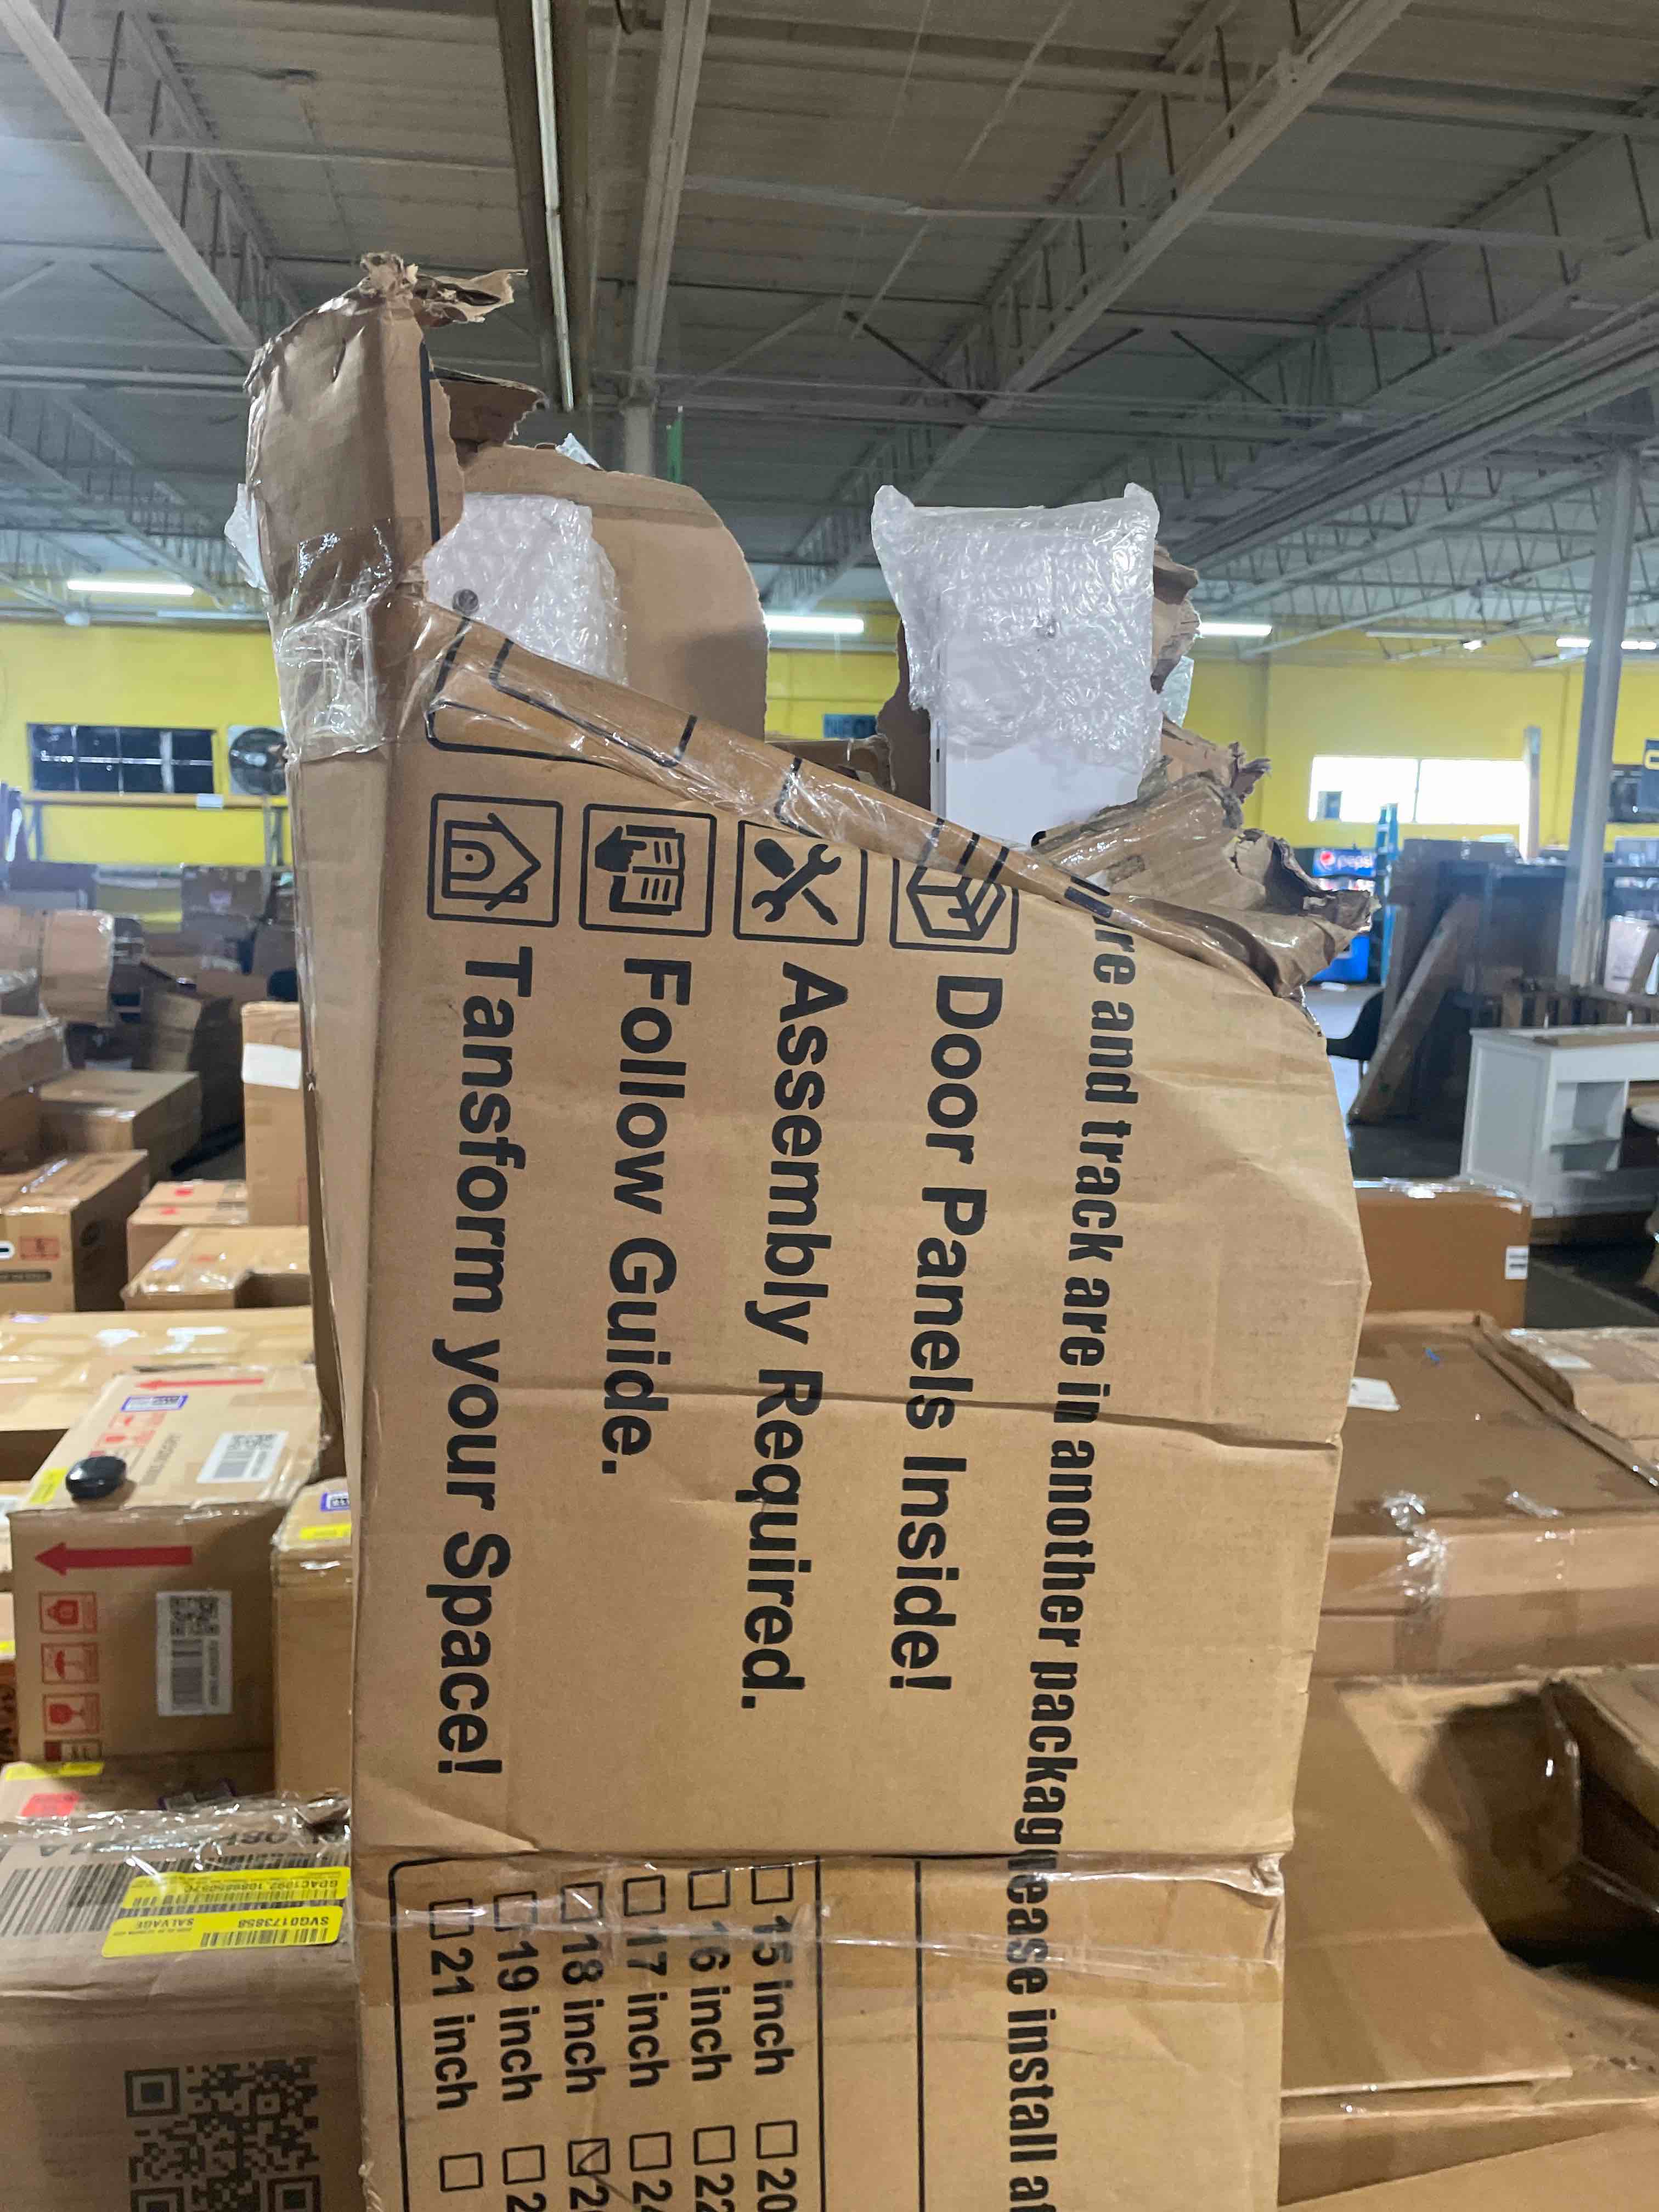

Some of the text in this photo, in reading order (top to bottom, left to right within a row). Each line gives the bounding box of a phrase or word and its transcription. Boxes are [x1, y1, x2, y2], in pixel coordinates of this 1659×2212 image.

[1093, 916, 1136, 984] re
[1085, 1001, 1138, 1103] and
[602, 958, 692, 1474] Follow Guide.
[1069, 1121, 1132, 1261] track
[427, 946, 533, 1774] Tansform your Space!
[736, 962, 848, 1708] Assembly Required.
[890, 976, 1003, 1690] Door Panels Inside!
[1060, 1277, 1110, 1365] are
[1054, 1383, 1110, 1423] in
[1039, 1441, 1095, 1647] another
[1015, 1662, 1077, 1855] packag
[689, 1921, 732, 2081] 16 inch
[752, 1915, 795, 2076] 15 inch
[1006, 1858, 1057, 1994] lease
[431, 1947, 478, 2110] 21 inch
[497, 1940, 543, 2102] 19 inch
[562, 1934, 607, 2094] 18 inch
[627, 1927, 670, 2088] 17 inch
[1008, 2009, 1058, 2163] install
[570, 2185, 610, 2212] 2
[633, 2180, 673, 2212] 2
